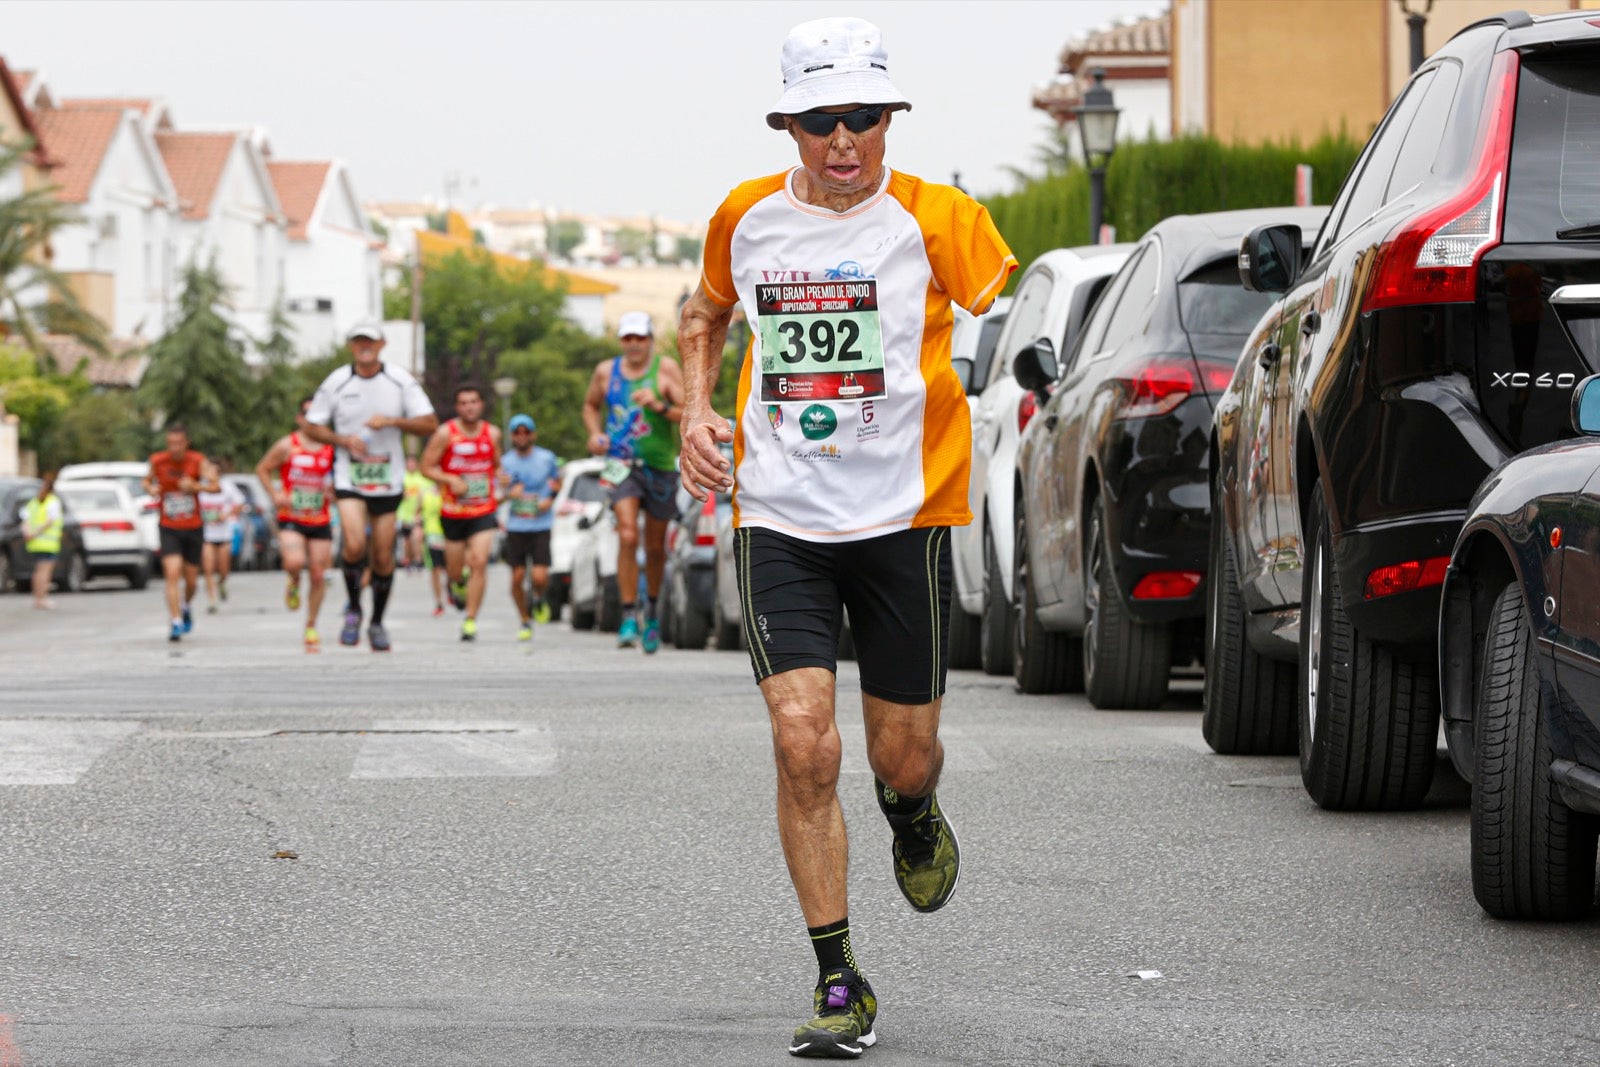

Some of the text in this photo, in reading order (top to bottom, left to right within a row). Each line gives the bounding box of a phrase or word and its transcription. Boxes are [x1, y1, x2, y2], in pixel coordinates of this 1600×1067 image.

[761, 283, 870, 301] XXXII GRAN PREMIO DE FONDO
[782, 300, 816, 312] DIPUTACIÓN
[778, 319, 863, 364] 392
